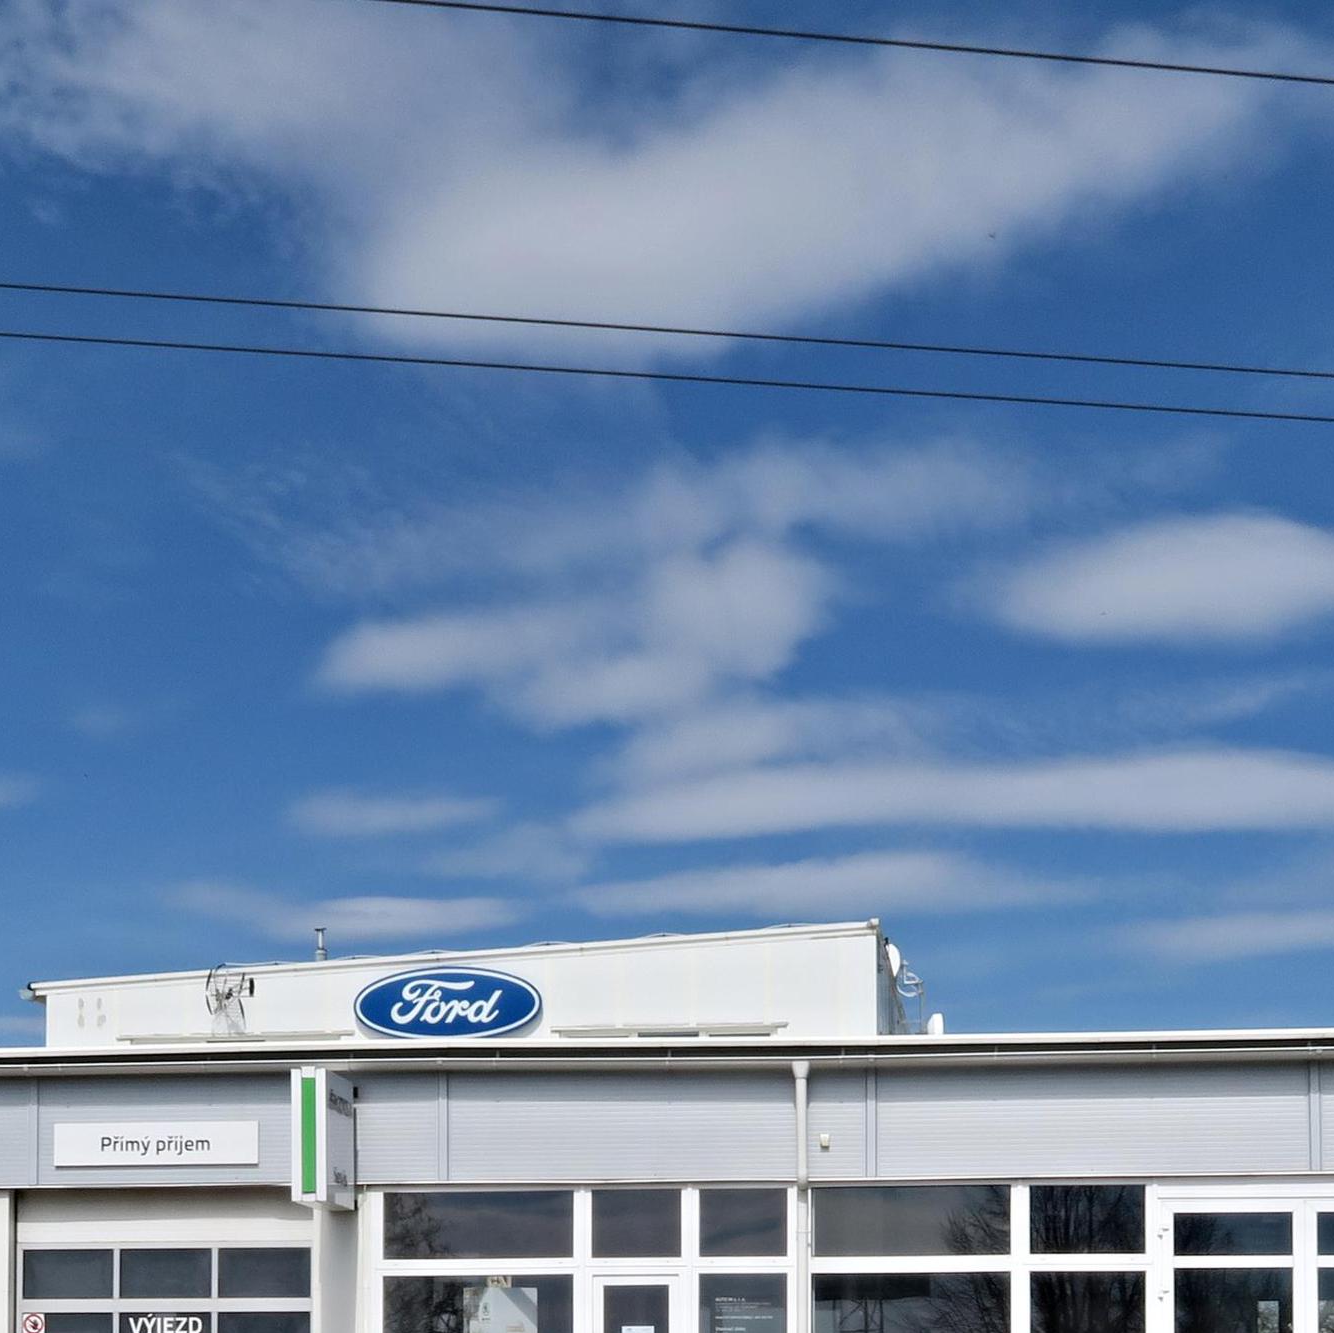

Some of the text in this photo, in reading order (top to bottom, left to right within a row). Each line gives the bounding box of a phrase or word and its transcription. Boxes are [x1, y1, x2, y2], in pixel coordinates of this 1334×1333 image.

[390, 979, 503, 1025] Ford
[100, 1136, 210, 1156] Přímý příjem
